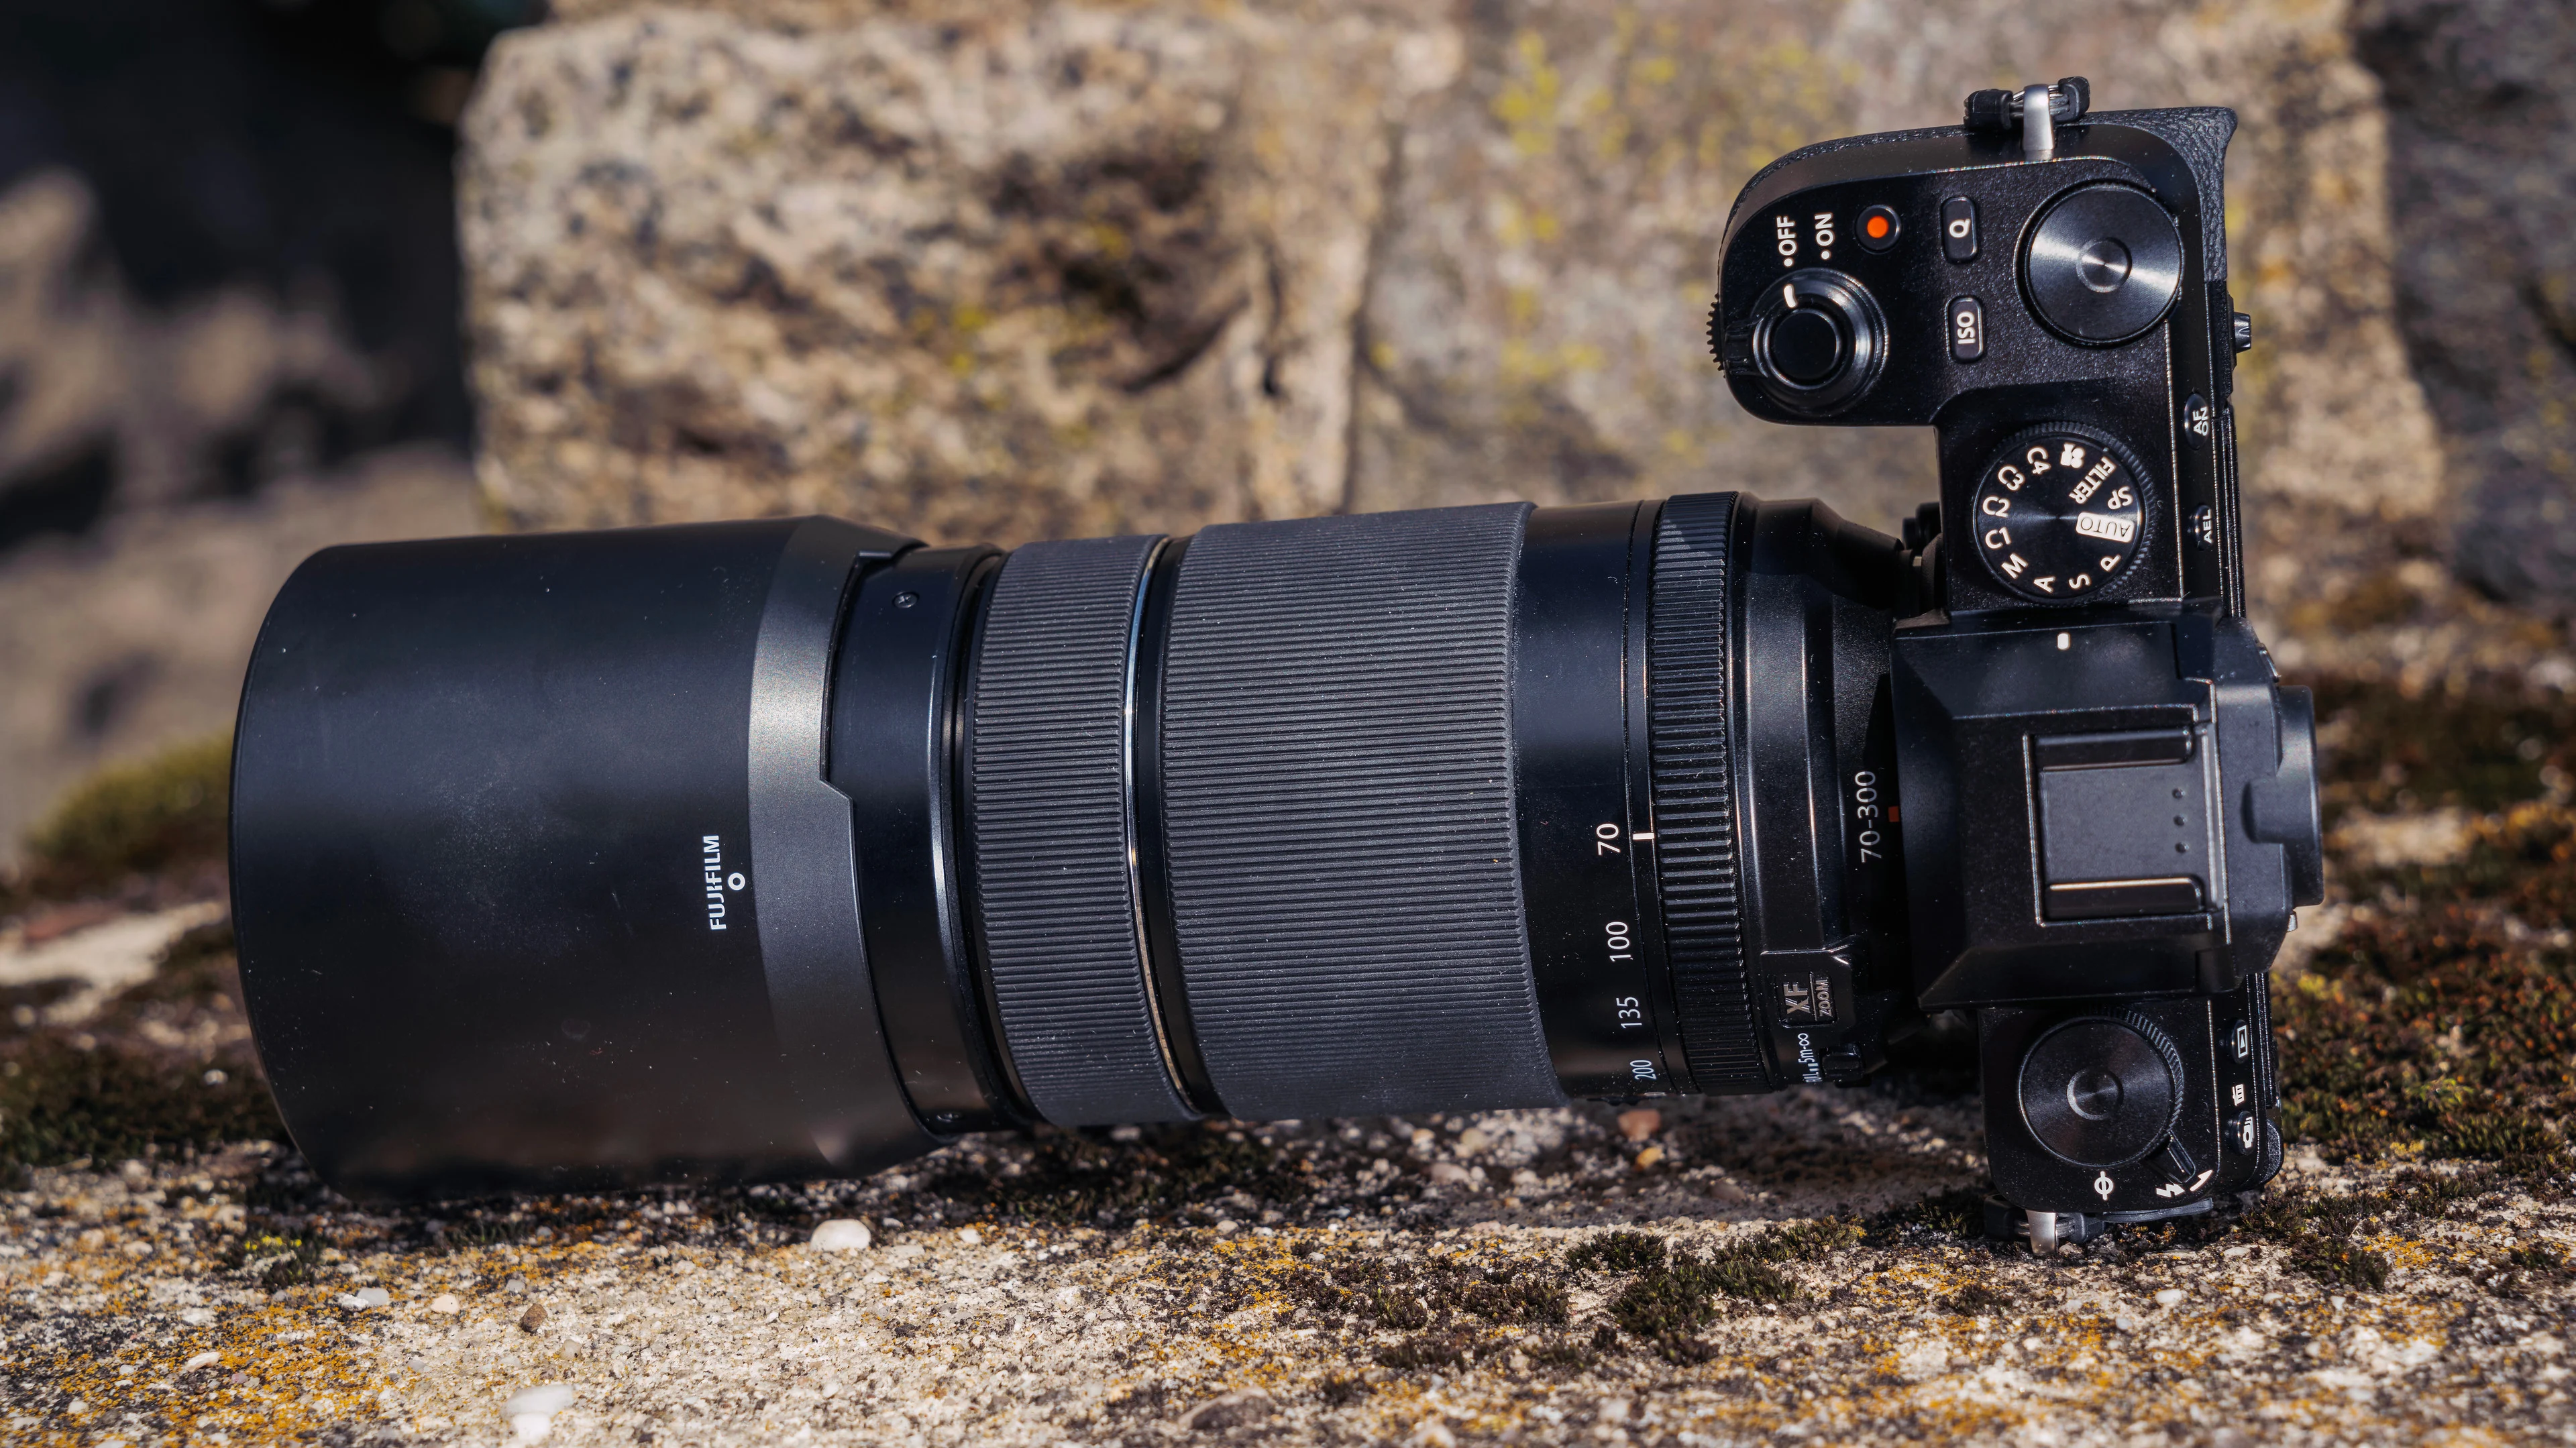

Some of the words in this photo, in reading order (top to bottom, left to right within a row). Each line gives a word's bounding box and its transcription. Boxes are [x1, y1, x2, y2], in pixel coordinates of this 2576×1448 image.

[1776, 215, 1797, 256] OFF
[1815, 213, 1834, 247] ON
[1949, 218, 1971, 238] Q
[1956, 311, 1976, 345] ISO
[2192, 410, 2202, 435] AF
[2200, 406, 2208, 436] ON
[2027, 447, 2051, 474] C4
[1998, 465, 2025, 491] C3
[2068, 455, 2116, 504] FILTER
[1982, 496, 2010, 518] C2
[2107, 486, 2133, 510] SP
[1984, 526, 2011, 549] C1
[2080, 516, 2131, 537] AUTO
[2202, 508, 2212, 544] AEL
[2001, 553, 2029, 579] M
[2100, 554, 2121, 571] P
[2033, 576, 2055, 593] A
[2068, 573, 2090, 590] S
[1854, 771, 1882, 863] 70-300
[1596, 823, 1621, 856] 70
[702, 835, 727, 930] FUJIFILM
[1605, 921, 1631, 962] 100
[1782, 981, 1811, 1015] XF
[1815, 977, 1833, 1017] ZOOM
[1615, 997, 1643, 1029] 135
[1629, 1060, 1657, 1080] 200
